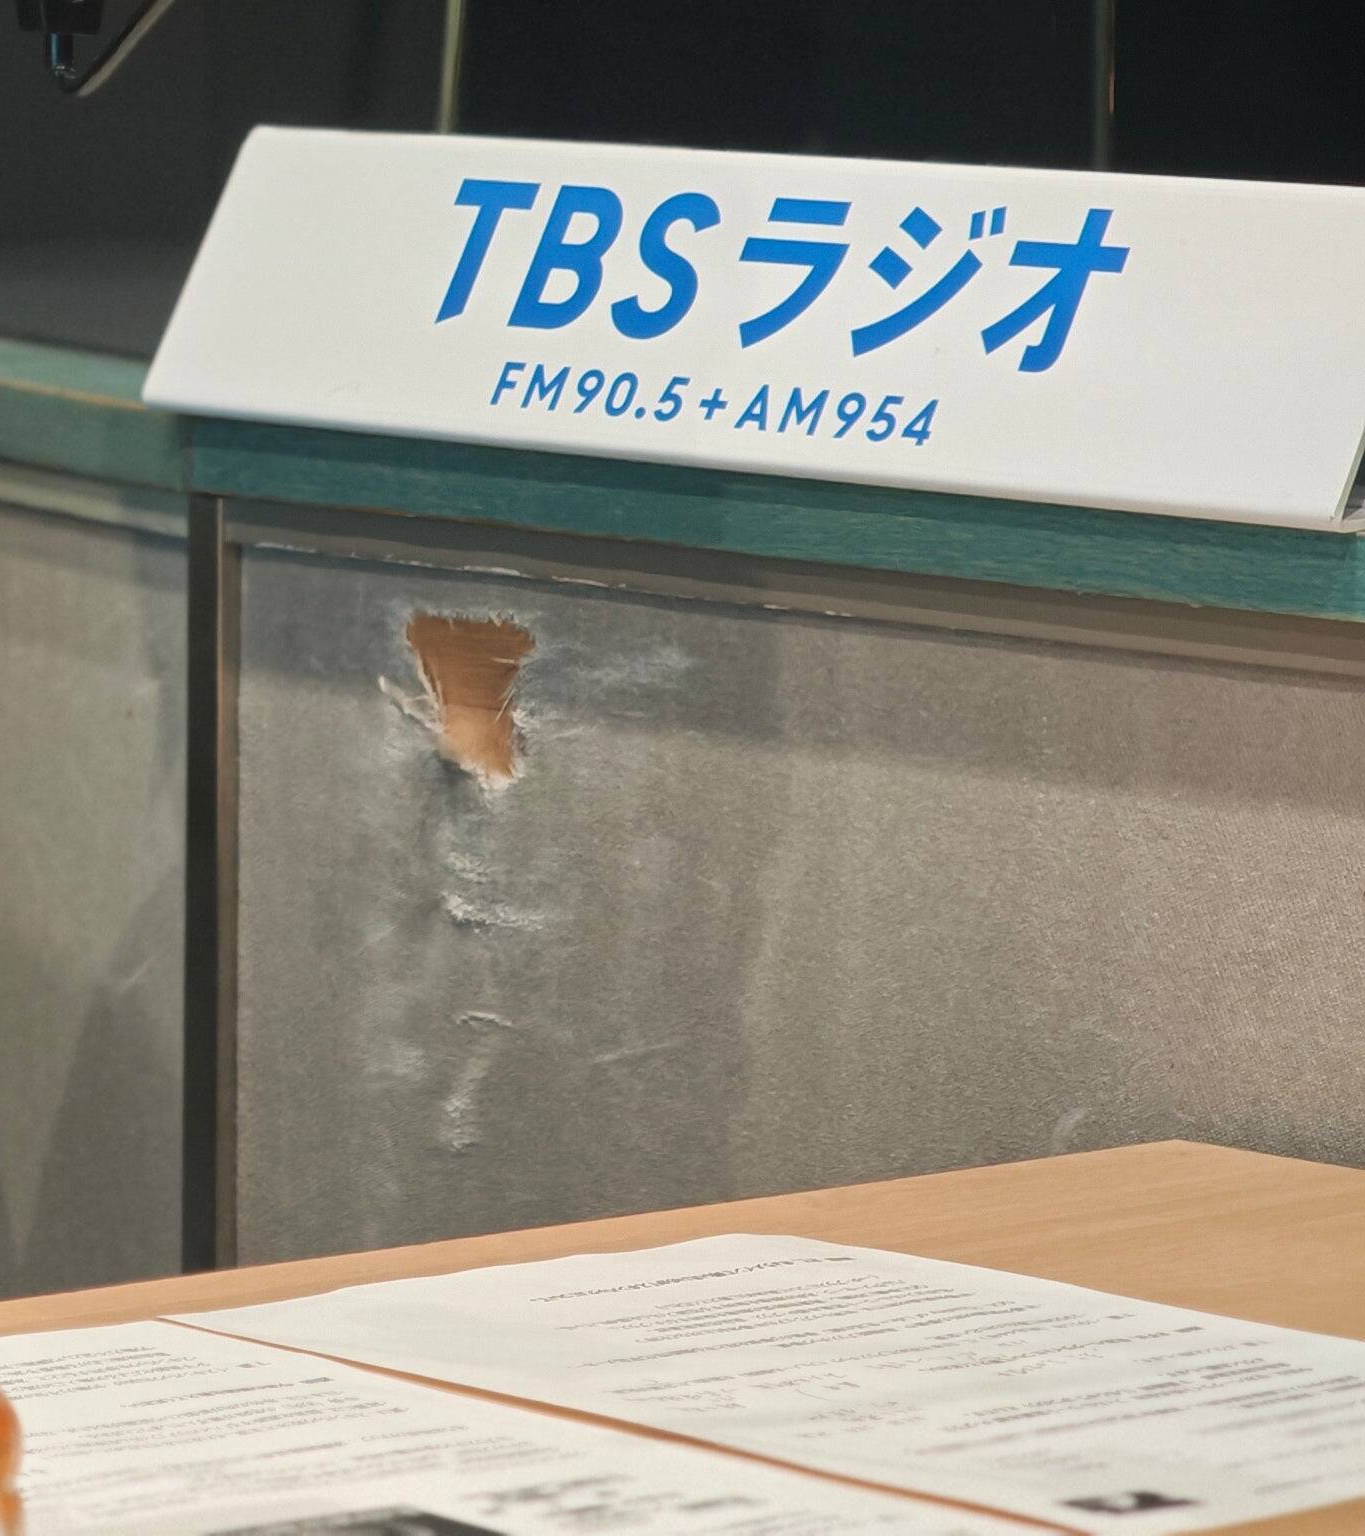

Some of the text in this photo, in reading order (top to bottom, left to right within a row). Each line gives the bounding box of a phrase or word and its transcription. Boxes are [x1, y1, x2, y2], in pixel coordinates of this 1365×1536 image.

[435, 178, 1130, 374] TBSラジオ
[490, 361, 940, 446] FM90.5+AM954
